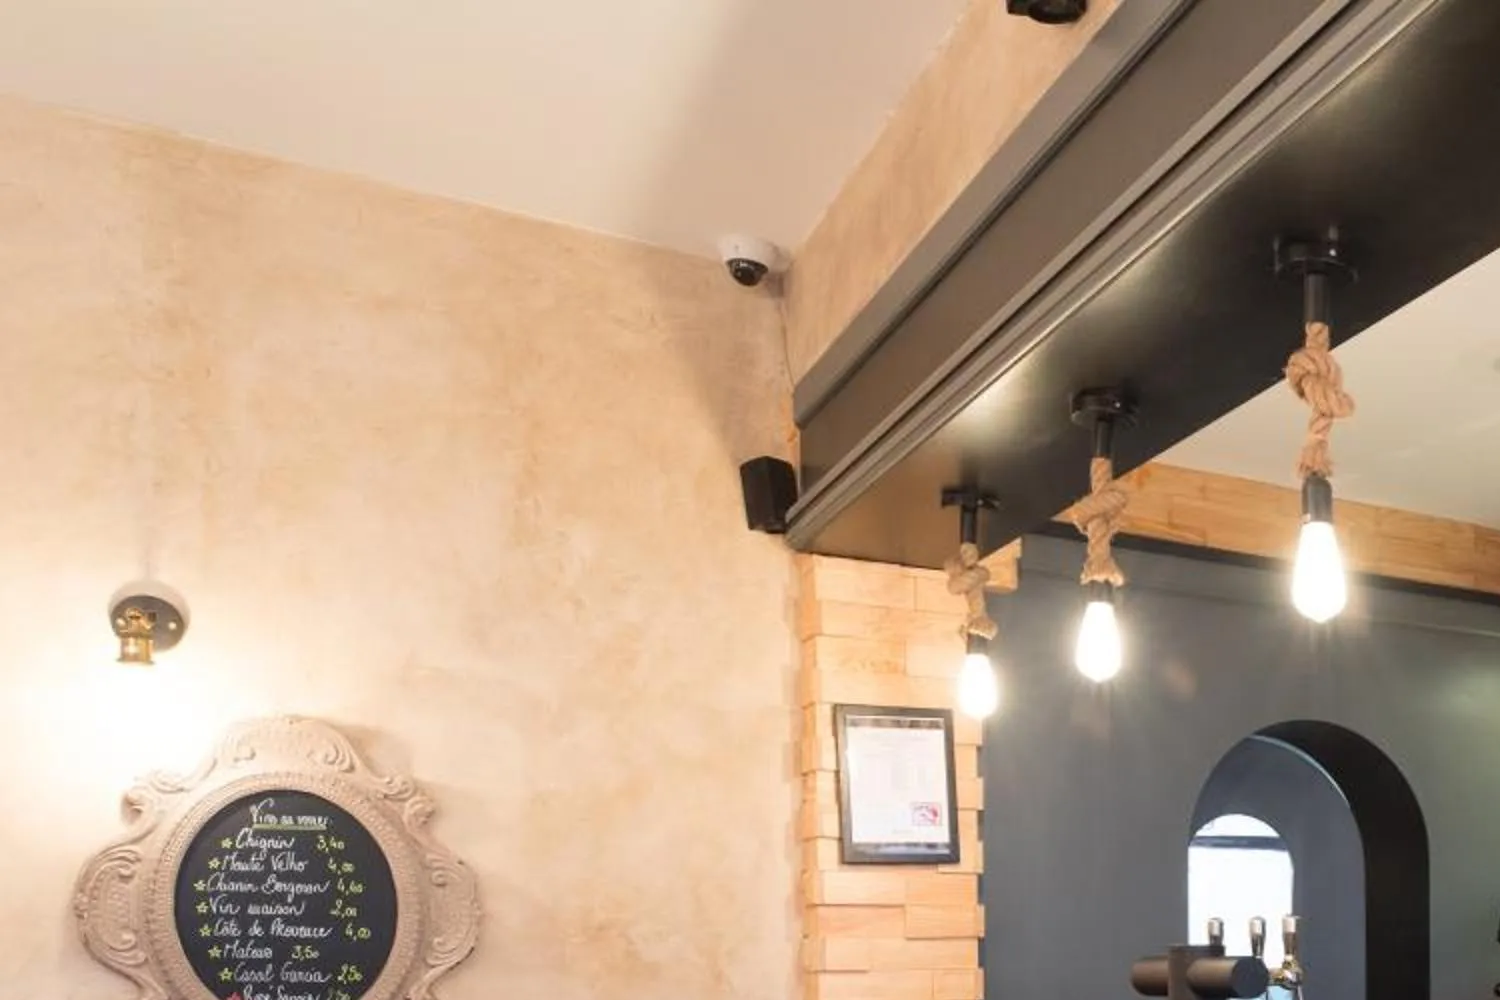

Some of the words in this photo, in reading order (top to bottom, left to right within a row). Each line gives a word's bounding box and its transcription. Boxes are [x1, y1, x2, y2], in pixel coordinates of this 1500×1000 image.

[209, 893, 240, 915] Vin
[247, 900, 305, 917] maison
[249, 918, 264, 937] de
[271, 917, 333, 938] Provence
